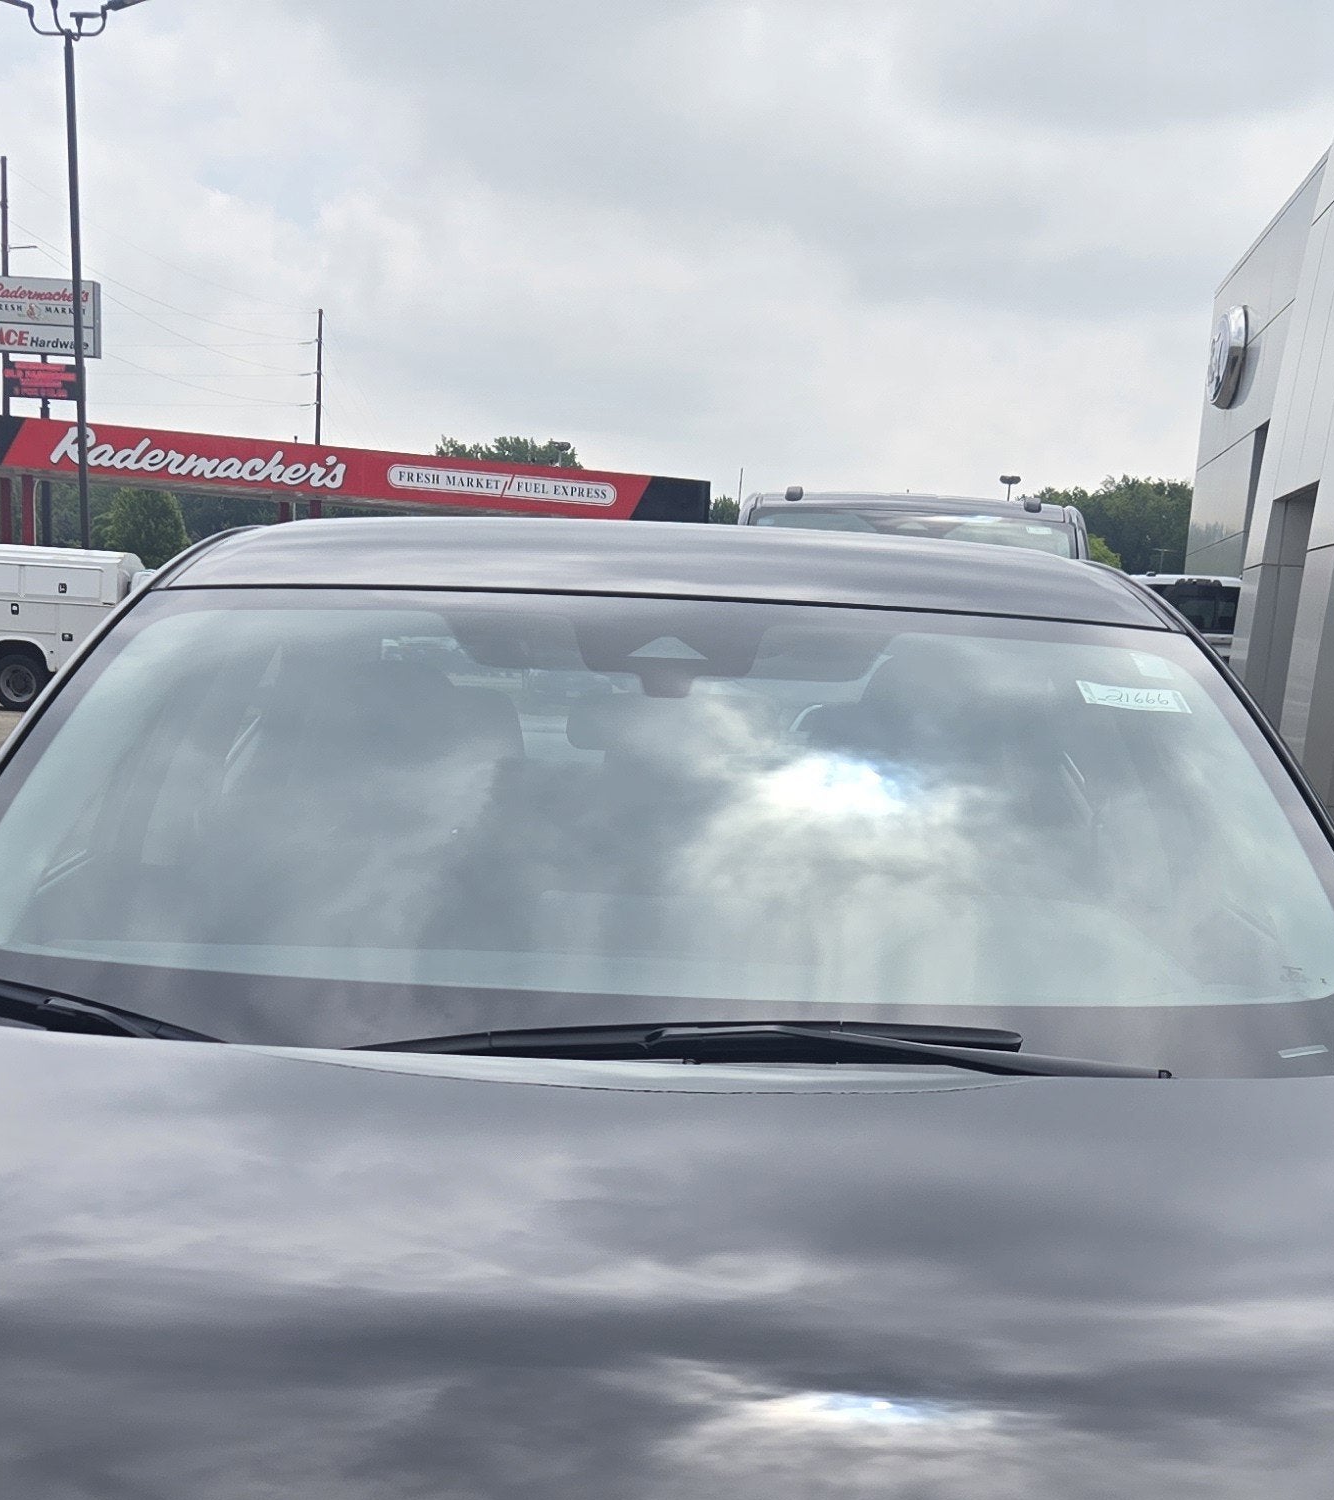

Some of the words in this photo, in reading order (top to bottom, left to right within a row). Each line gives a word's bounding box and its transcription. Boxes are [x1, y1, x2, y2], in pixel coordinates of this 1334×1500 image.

[45, 306, 86, 315] MARKT
[30, 337, 89, 350] Hardwae
[49, 426, 346, 489] Radermacher's
[398, 470, 440, 485] FRESH
[445, 475, 502, 491] MARKET
[516, 481, 549, 495] FUEL
[553, 485, 608, 500] EXPRESS
